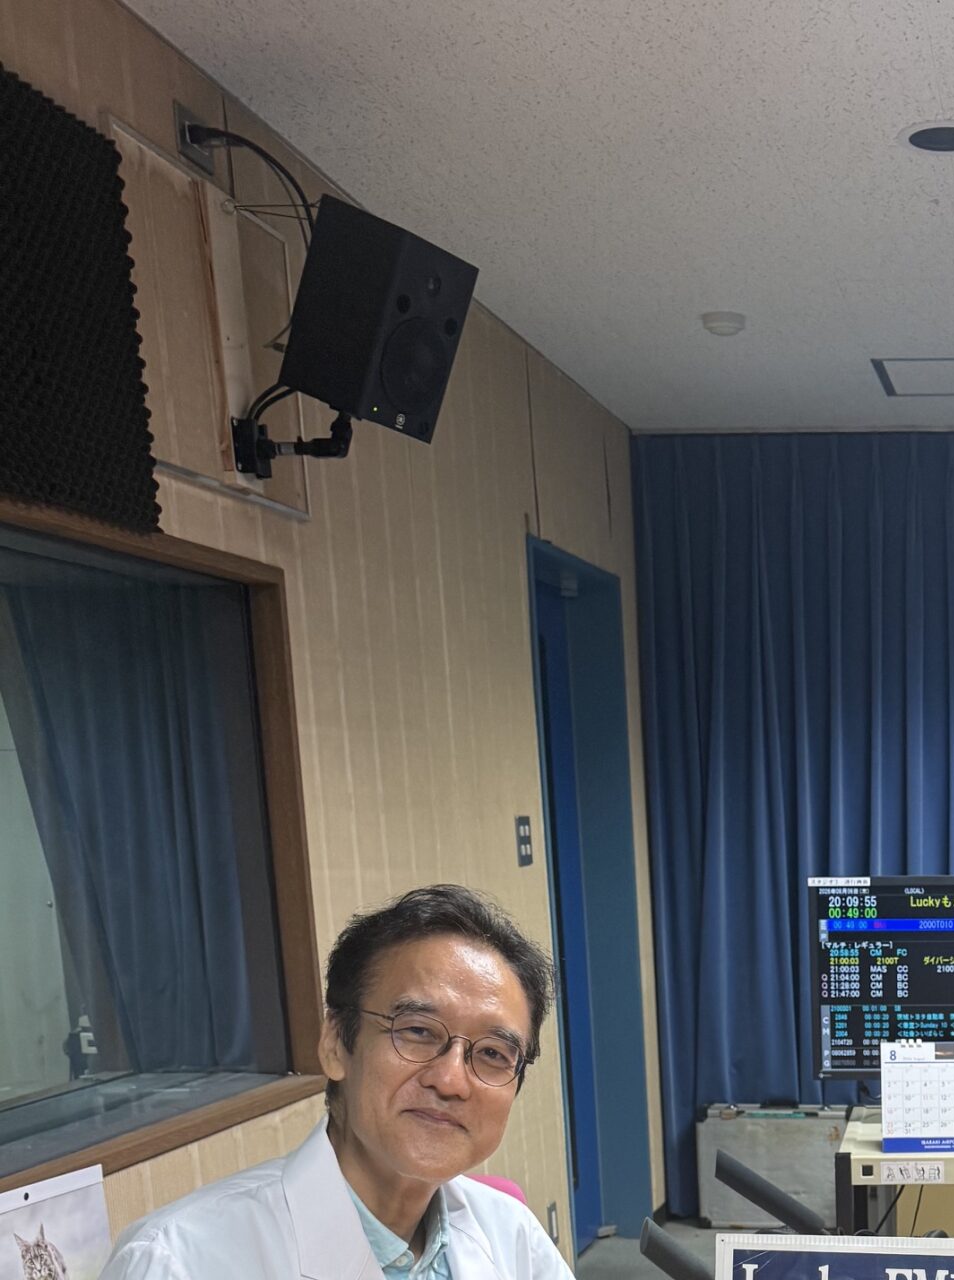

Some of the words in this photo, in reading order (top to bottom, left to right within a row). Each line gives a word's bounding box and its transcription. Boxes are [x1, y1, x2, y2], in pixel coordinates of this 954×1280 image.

[829, 896, 877, 907] 20:09:55
[829, 908, 877, 918] 00:49:00
[890, 1050, 896, 1060] 8
